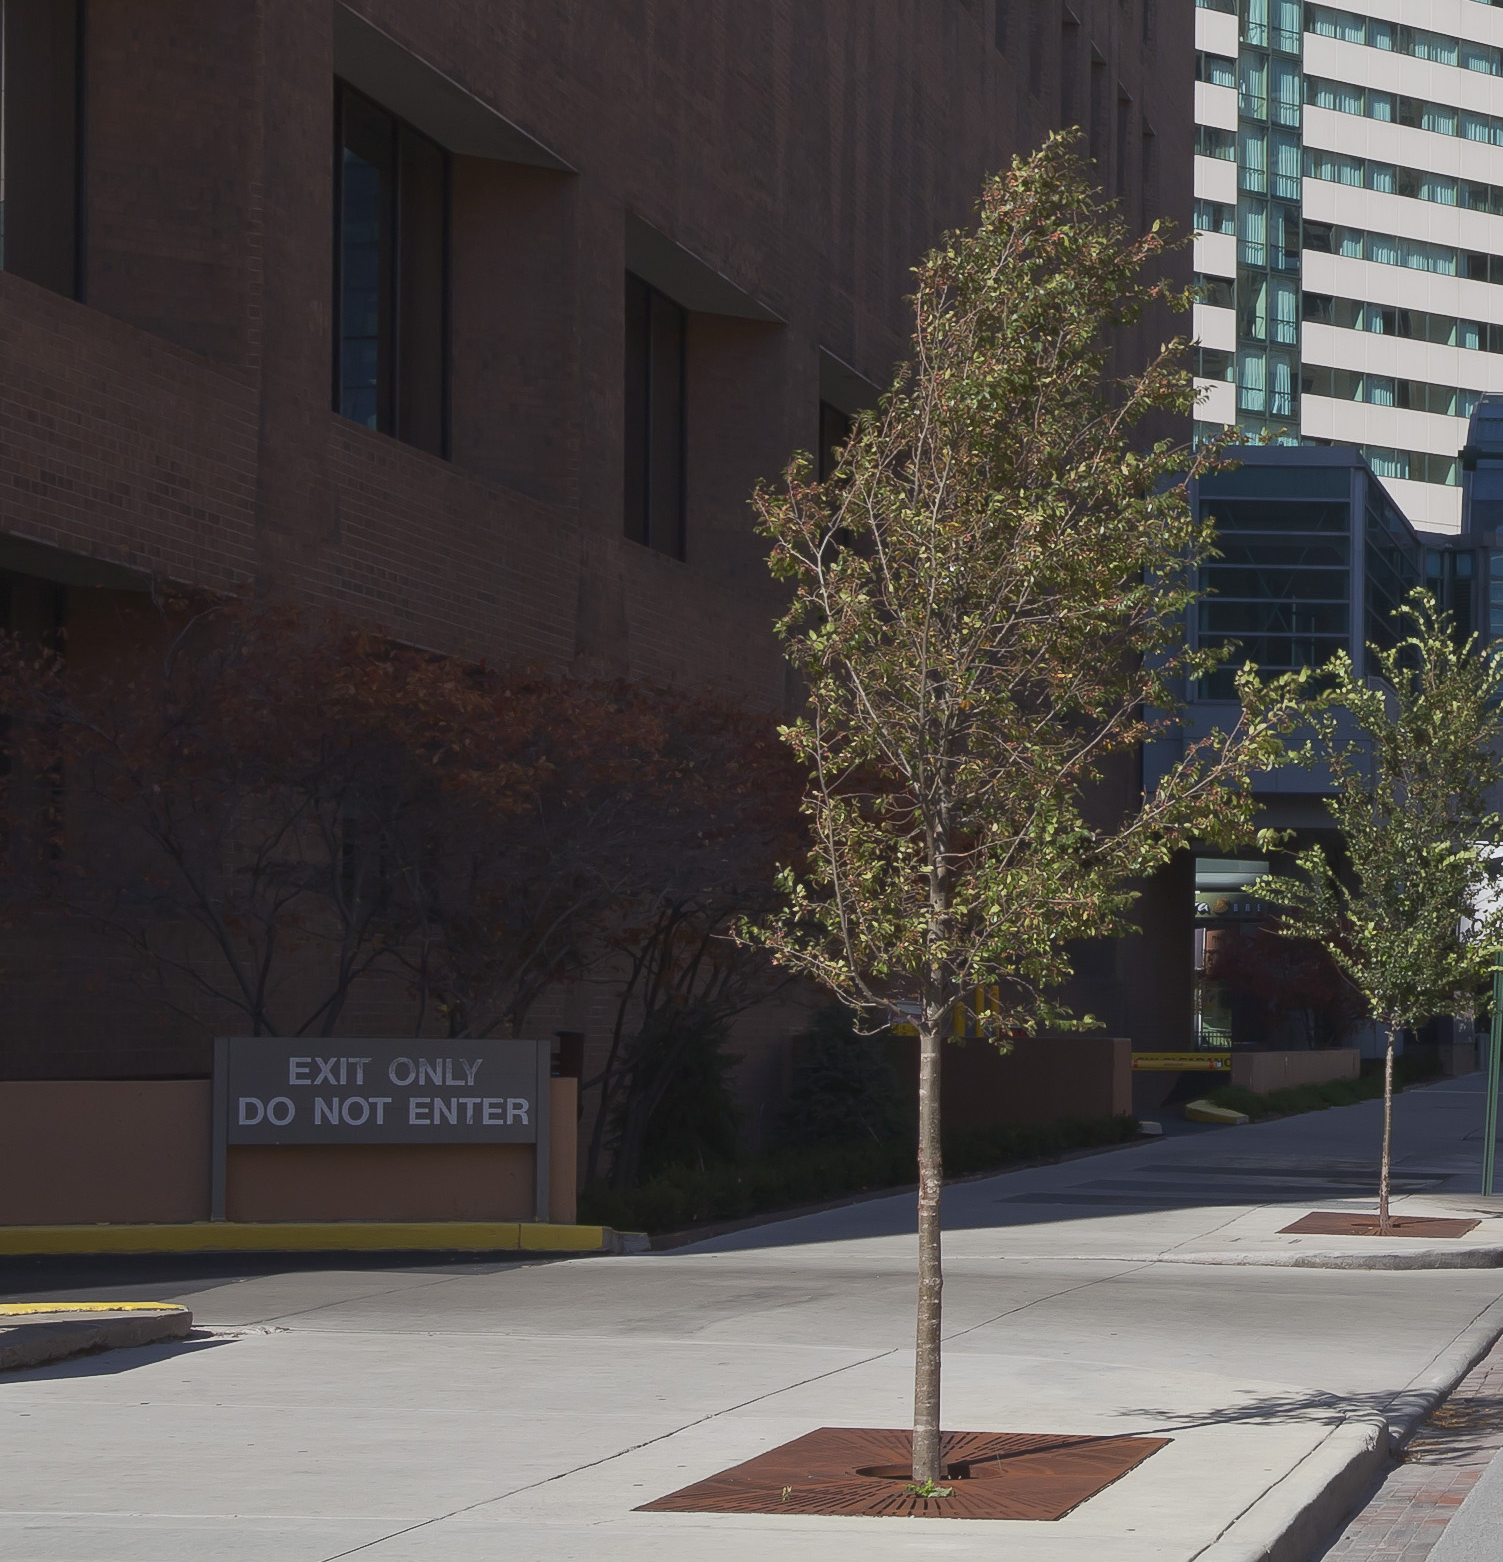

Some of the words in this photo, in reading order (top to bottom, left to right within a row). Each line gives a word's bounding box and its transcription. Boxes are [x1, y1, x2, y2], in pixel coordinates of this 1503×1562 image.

[288, 1056, 373, 1085] EXIT
[388, 1056, 483, 1086] ONLY
[238, 1096, 296, 1126] DO
[314, 1096, 392, 1126] NOT
[408, 1097, 530, 1126] ENTER
